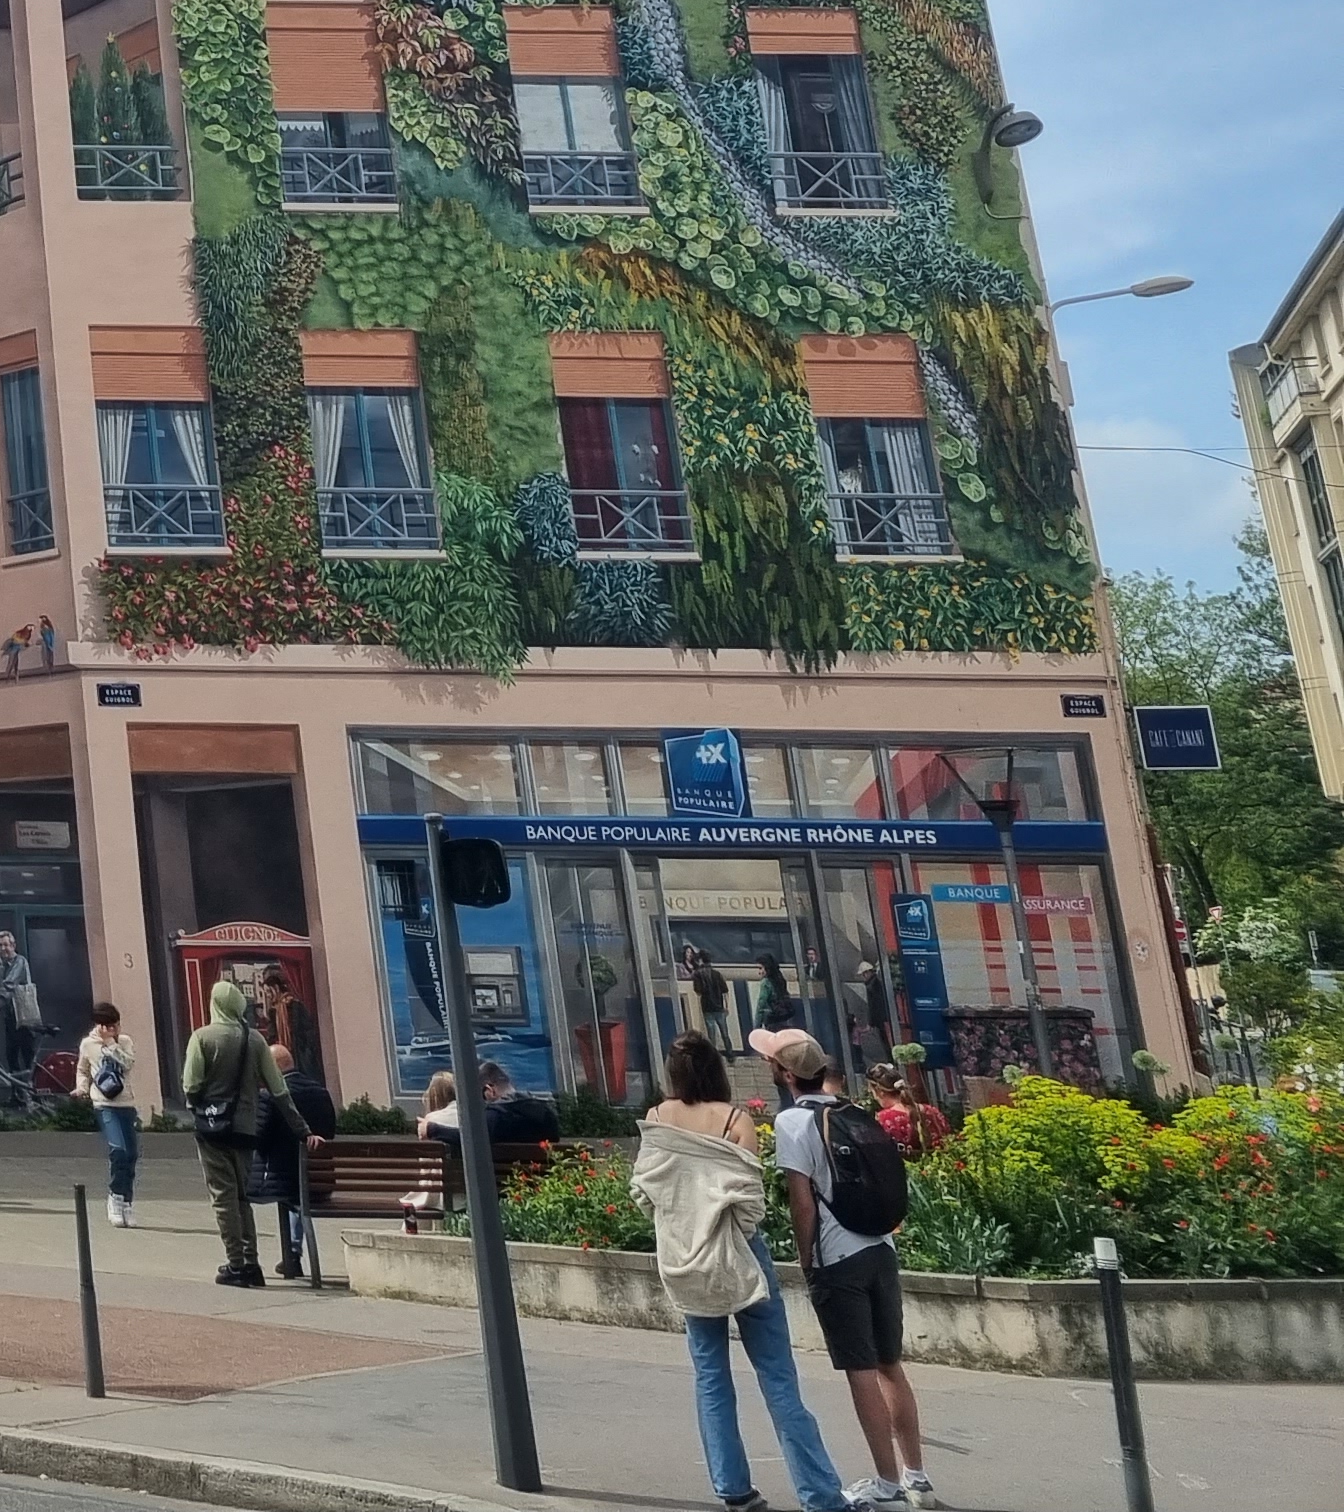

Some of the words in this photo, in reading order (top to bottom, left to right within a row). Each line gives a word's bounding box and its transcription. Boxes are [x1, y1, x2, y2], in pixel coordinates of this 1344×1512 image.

[104, 696, 135, 704] GUIGNOL
[1069, 699, 1097, 707] ESPACE
[1069, 707, 1100, 715] GUIGNOL
[676, 787, 733, 799] BANQUE
[677, 796, 735, 810] POPULAIRE
[525, 825, 598, 843] BANQUE
[601, 826, 692, 842] POPULAIRE
[698, 827, 802, 843] AUVERGNE
[807, 824, 875, 843] RHÔNE
[879, 829, 937, 844] ALPES
[947, 887, 1001, 899] BANQUE
[215, 926, 283, 943] GUIGNOL
[123, 953, 135, 969] 3
